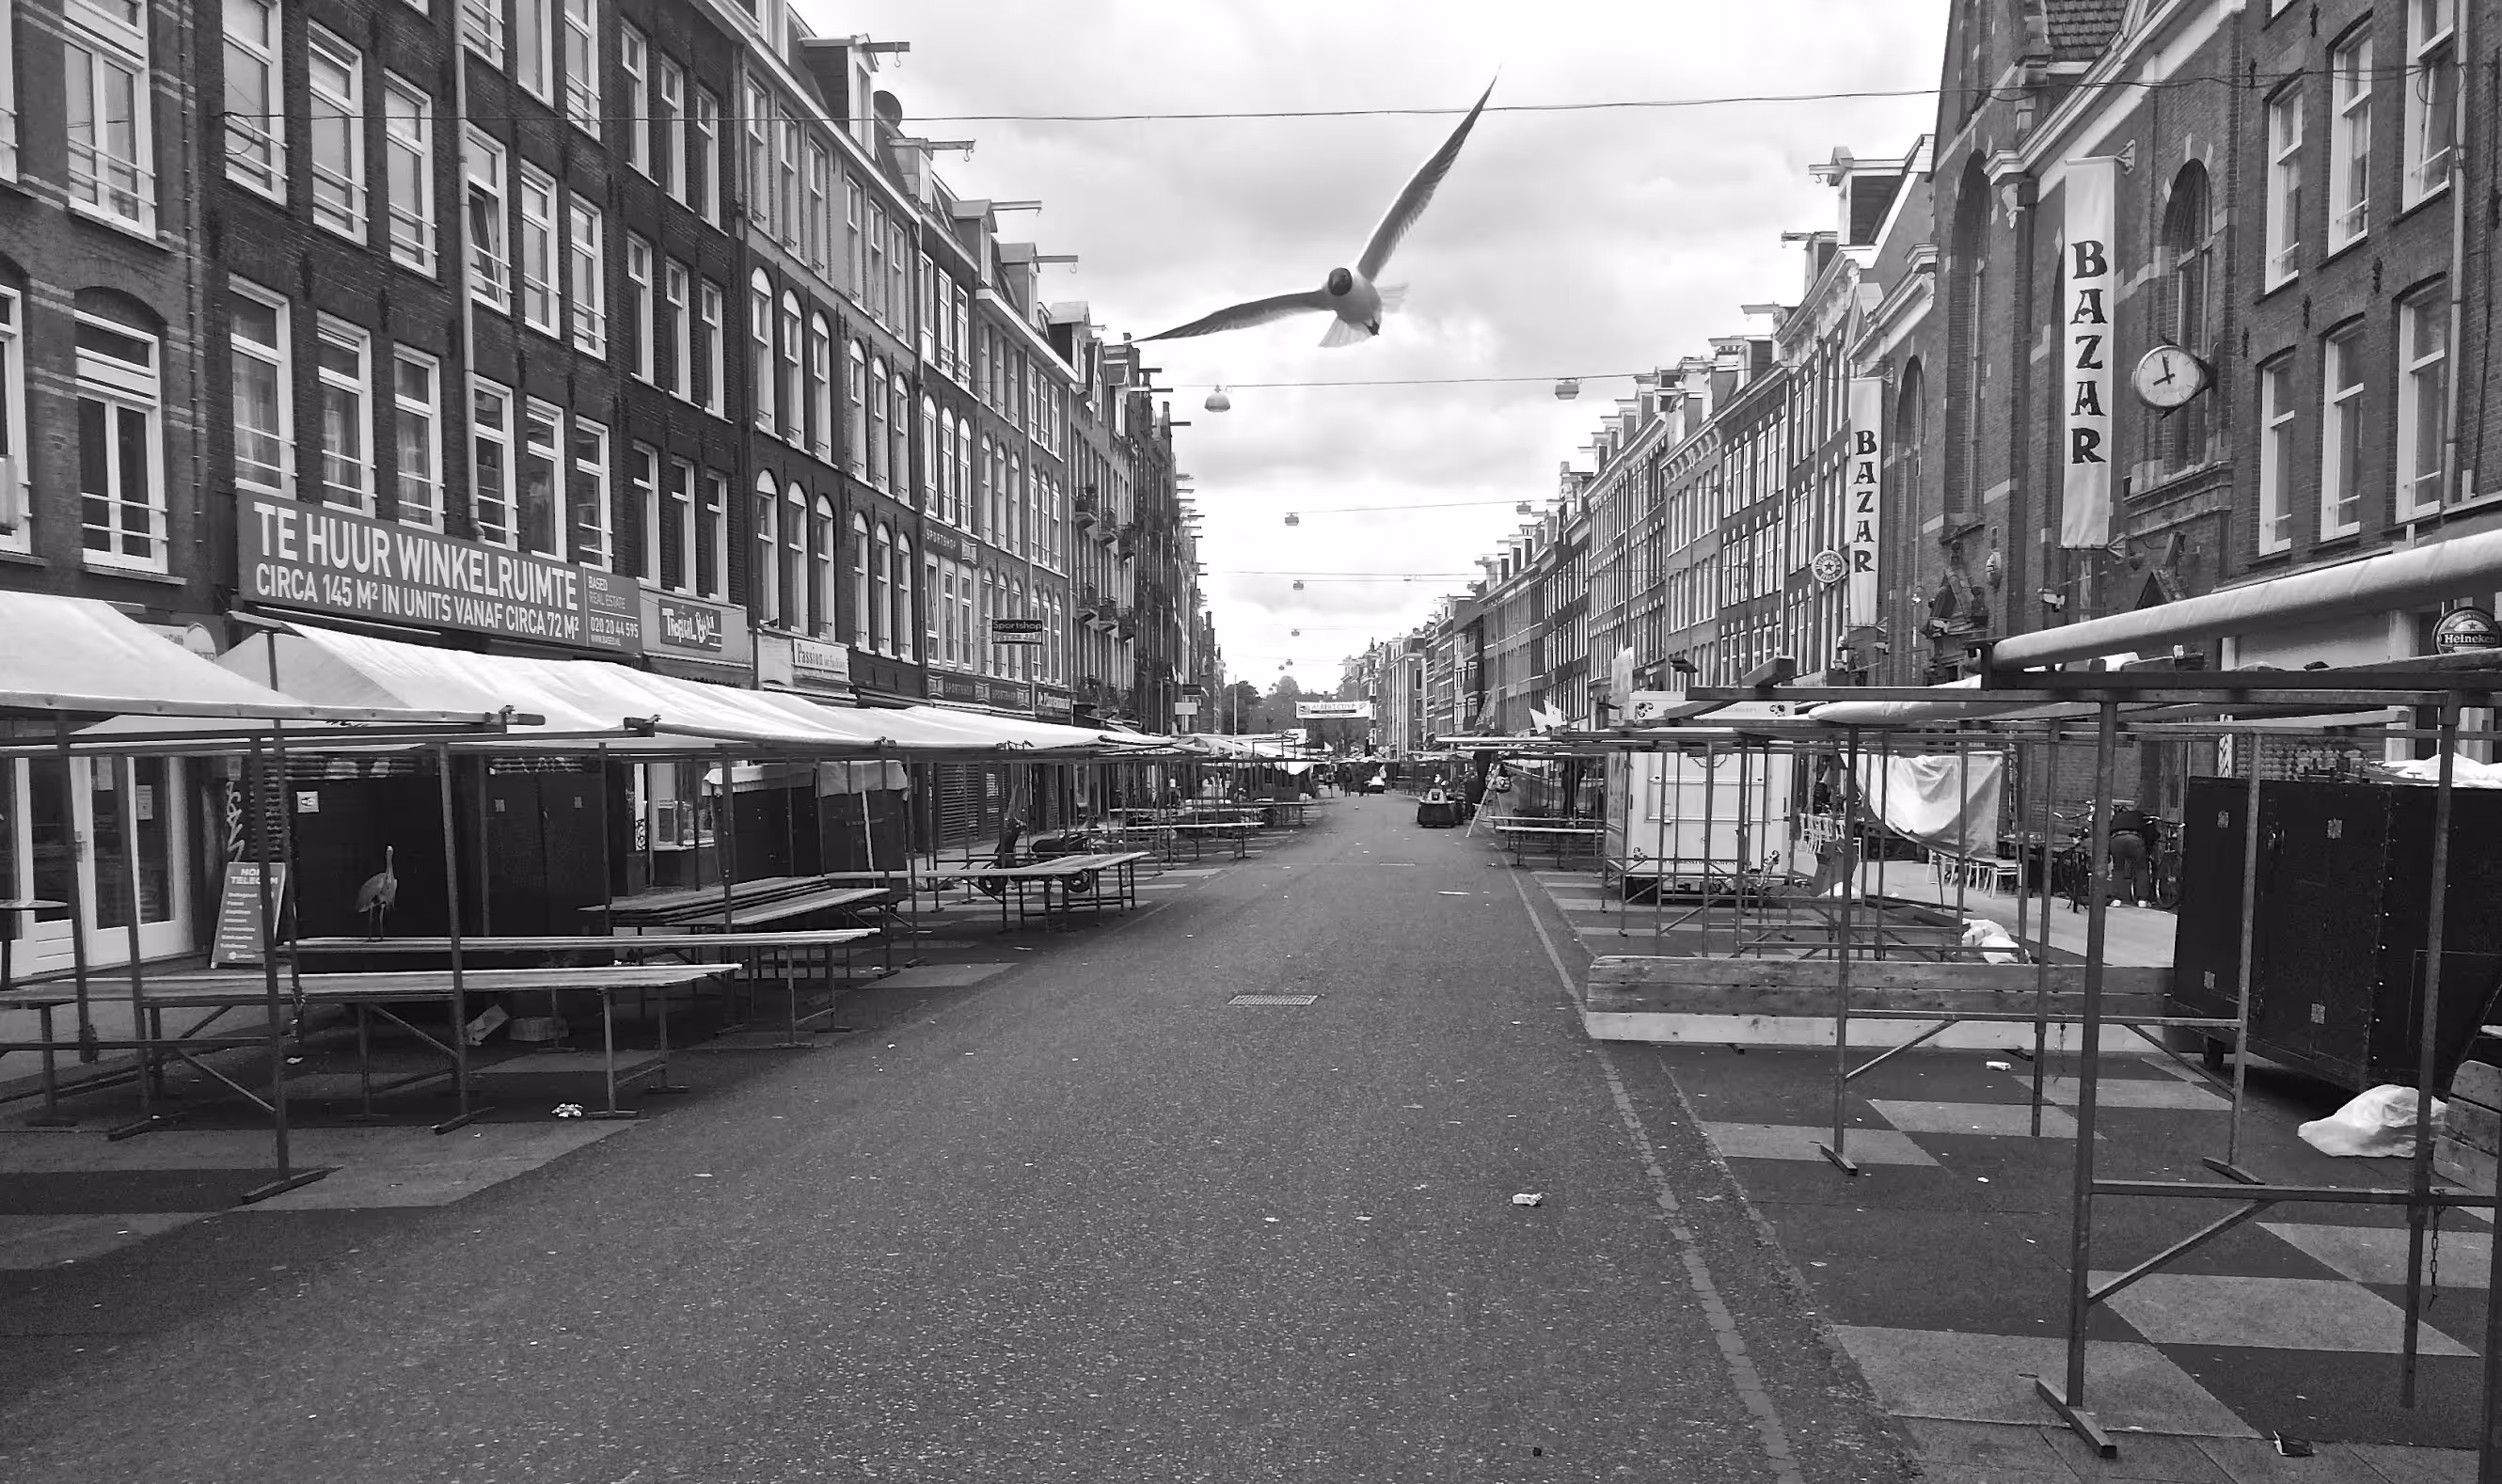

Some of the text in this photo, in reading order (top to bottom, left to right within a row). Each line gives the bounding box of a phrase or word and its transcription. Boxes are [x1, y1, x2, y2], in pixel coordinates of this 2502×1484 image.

[2069, 240, 2108, 464] BAZAR
[1853, 430, 1877, 574] BAZAR
[254, 501, 578, 611] TE HUUR WINKELRUIMTE
[588, 576, 609, 592] BASED
[256, 562, 579, 640] CIRCA 145 M² IN UNITS VANAF CIRCA 72 M²
[589, 592, 626, 609] REAL ESTATE
[590, 616, 639, 639] 020 20 44 595
[992, 621, 1042, 631] Sportshop
[2445, 634, 2495, 644] Heineken
[797, 642, 823, 666] Passion
[944, 682, 974, 697] SPORTSHOP
[991, 688, 1017, 702] SPORTSHOP
[230, 876, 278, 885] TELECM
